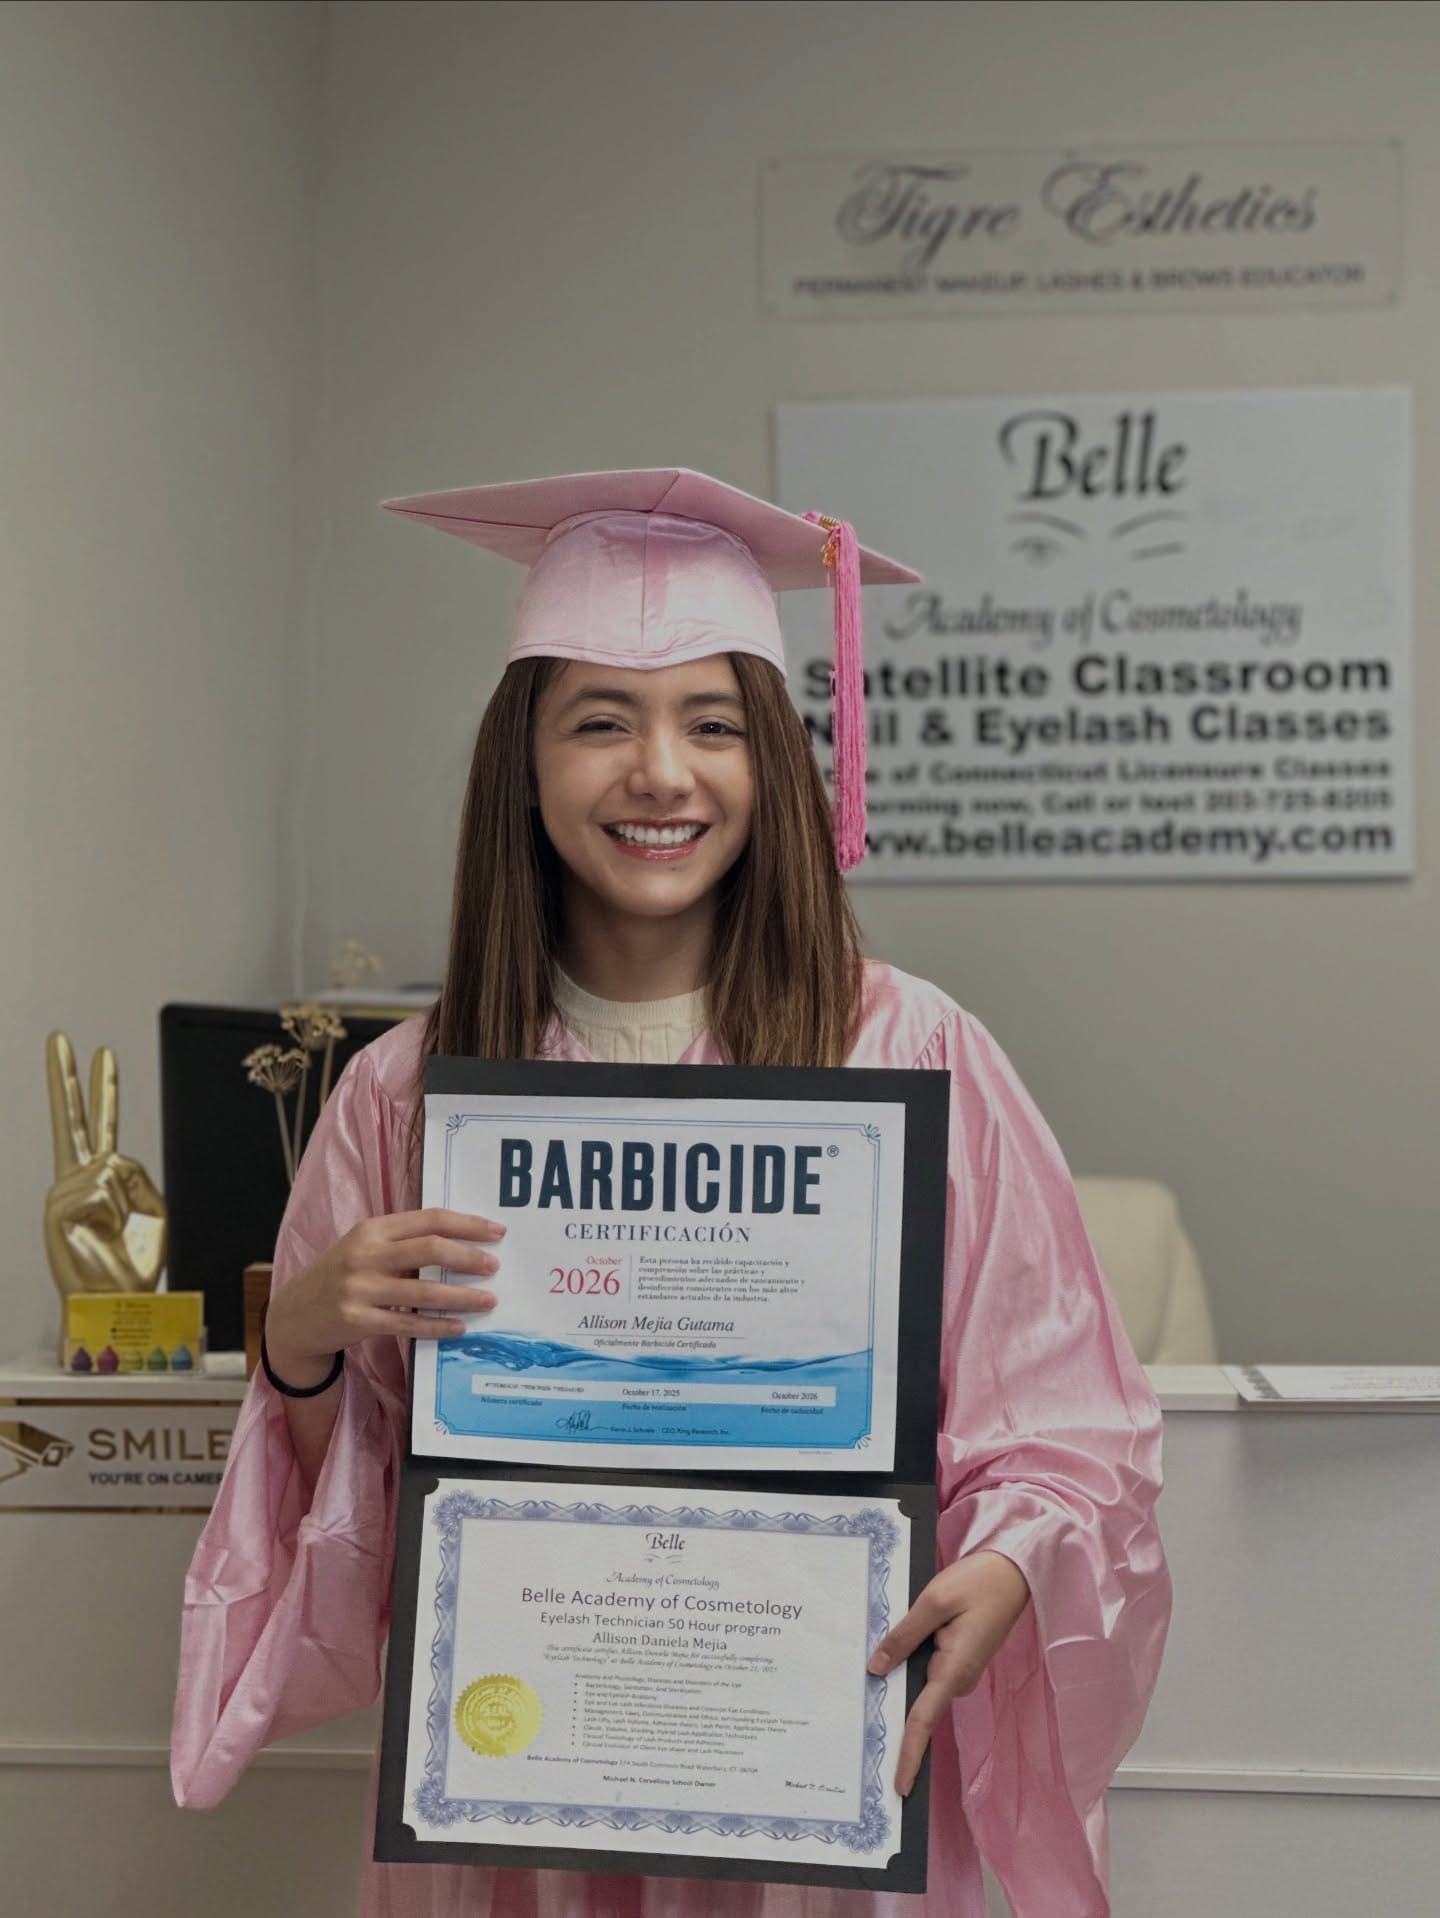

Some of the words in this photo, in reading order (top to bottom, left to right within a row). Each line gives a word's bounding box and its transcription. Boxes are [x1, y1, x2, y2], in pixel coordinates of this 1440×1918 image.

[835, 162, 1022, 271] Tigre
[1042, 160, 1318, 246] Esthetics
[998, 410, 1188, 500] Belle
[882, 591, 1055, 651] Academy
[1061, 588, 1097, 647] of
[1100, 586, 1303, 648] Cosmetology
[804, 655, 1050, 700] Stellite
[1071, 652, 1391, 699] Classroom
[802, 708, 899, 747] Nil
[919, 707, 954, 748] &
[974, 705, 1171, 755] Eyelash
[1188, 701, 1392, 743] Classes
[565, 1222, 752, 1244] CERTIFICACIÓN
[586, 1255, 622, 1266] October
[549, 1268, 621, 1296] 2026
[578, 1315, 627, 1330] Allison
[631, 1315, 673, 1333] Mejia
[677, 1316, 735, 1332] Gutama
[622, 1388, 649, 1397] October
[772, 1391, 799, 1400] October
[88, 1428, 233, 1461] SMILE
[89, 1471, 143, 1486] YOU'RE
[147, 1472, 169, 1486] ON
[645, 1532, 686, 1550] Belle
[606, 1571, 653, 1585] Academy
[655, 1573, 665, 1587] of
[665, 1574, 720, 1590] Cosmetology
[522, 1587, 566, 1604] Belle
[571, 1590, 654, 1611] Academy
[660, 1594, 680, 1610] of
[684, 1595, 803, 1620] Cosmetology
[540, 1612, 590, 1627] Eyelash
[594, 1614, 665, 1629] Technician
[668, 1617, 685, 1630] 50
[688, 1619, 720, 1633] Hour
[725, 1622, 782, 1637] program
[592, 1632, 638, 1646] Allison
[641, 1634, 689, 1649] Daniela
[693, 1637, 727, 1651] Mejia
